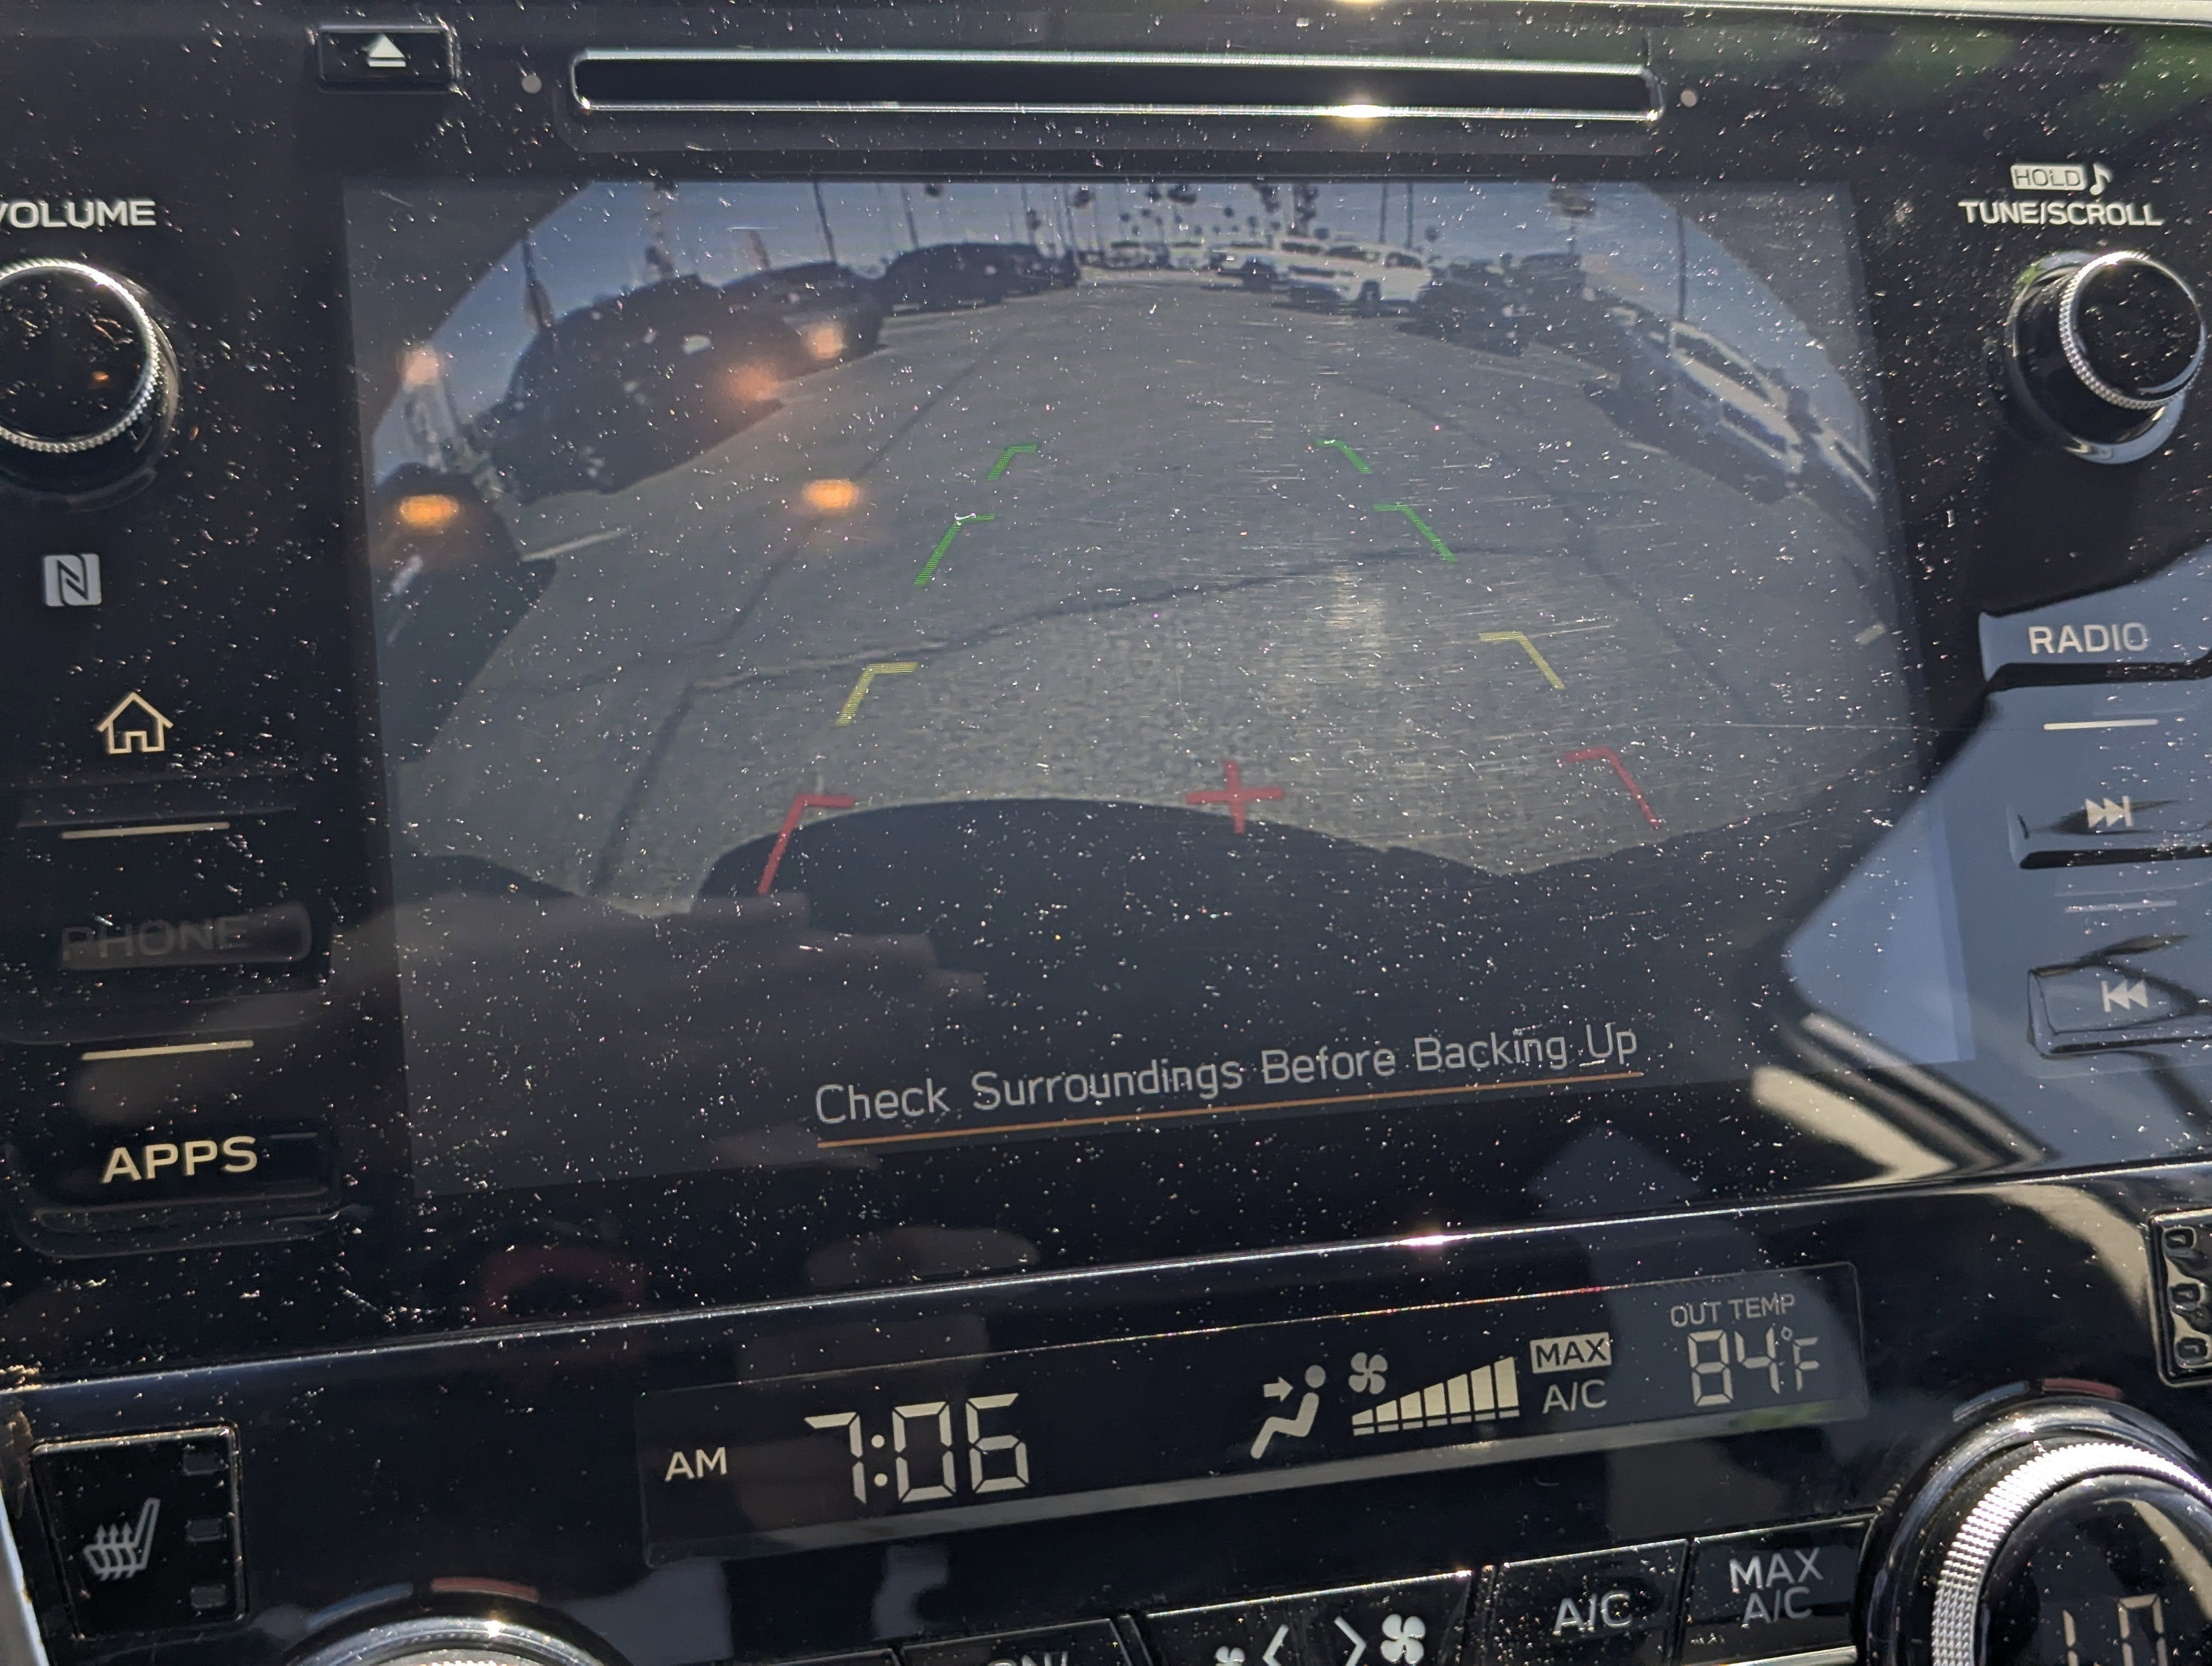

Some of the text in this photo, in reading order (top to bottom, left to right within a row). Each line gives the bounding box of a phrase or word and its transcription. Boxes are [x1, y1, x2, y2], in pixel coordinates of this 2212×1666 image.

[2014, 169, 2082, 187] HOLD
[1958, 200, 2164, 226] TUNE/SCROLL
[2028, 622, 2148, 654] RADIO
[62, 919, 250, 961] PHONE
[815, 1022, 1638, 1124] Check Surroundings Before Backing Up
[101, 1136, 258, 1183] APPS
[1670, 1293, 1795, 1327] OUT TEMP
[1536, 1338, 1607, 1370] MAX
[1542, 1379, 1606, 1414] A/C
[664, 1393, 1030, 1504] AM 7:06
[1729, 1547, 1824, 1590] MAX
[1553, 1590, 1632, 1637] A/C
[1741, 1586, 1813, 1629] A/C
